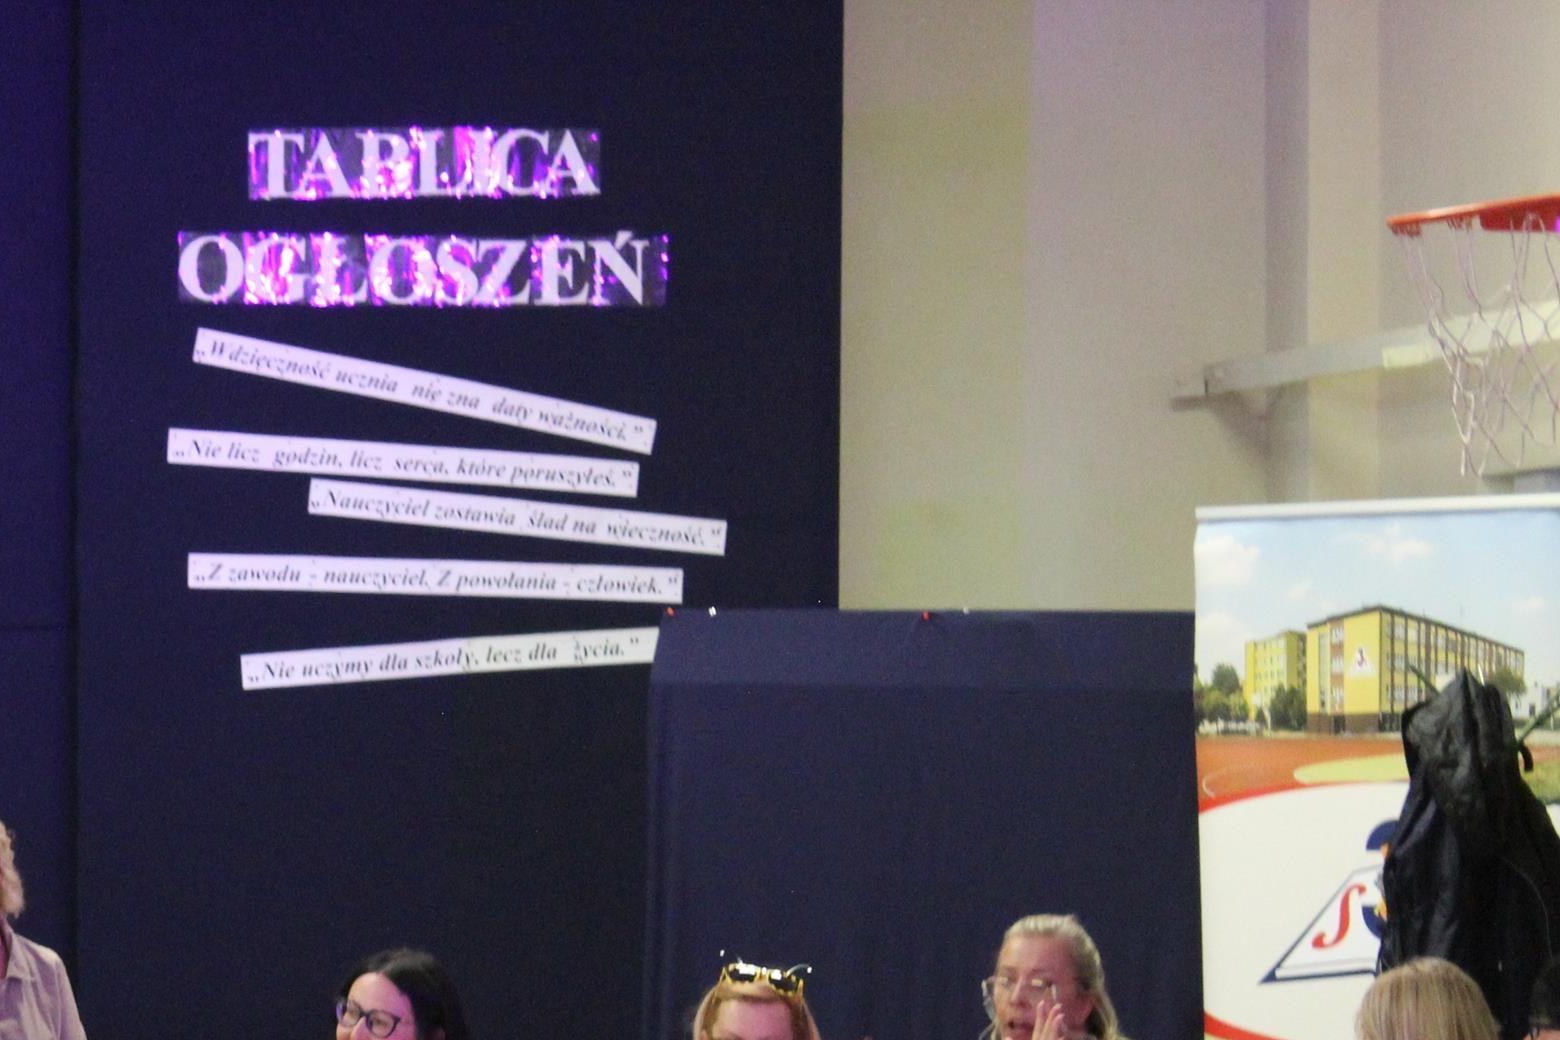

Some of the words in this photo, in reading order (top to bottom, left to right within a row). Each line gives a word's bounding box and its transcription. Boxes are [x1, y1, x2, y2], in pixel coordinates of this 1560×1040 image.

[249, 128, 600, 198] TABLICA
[178, 231, 650, 306] OGŁOSZEŃ
[335, 371, 399, 394] ucznia
[411, 382, 441, 400] nie
[446, 391, 480, 410] zna
[492, 396, 533, 423] daty
[227, 441, 260, 462] licz
[272, 446, 343, 468] godzin,
[350, 450, 383, 471] licz
[457, 457, 506, 478] które
[434, 505, 516, 527] zostawia
[528, 509, 568, 532] ślad
[572, 520, 597, 534] na
[228, 565, 301, 582] zawodu
[437, 569, 452, 586] Z
[455, 570, 556, 592] powołania
[301, 660, 374, 682] uczymy
[379, 653, 409, 672] dla
[486, 646, 522, 664] lecz
[528, 642, 558, 661] dla
